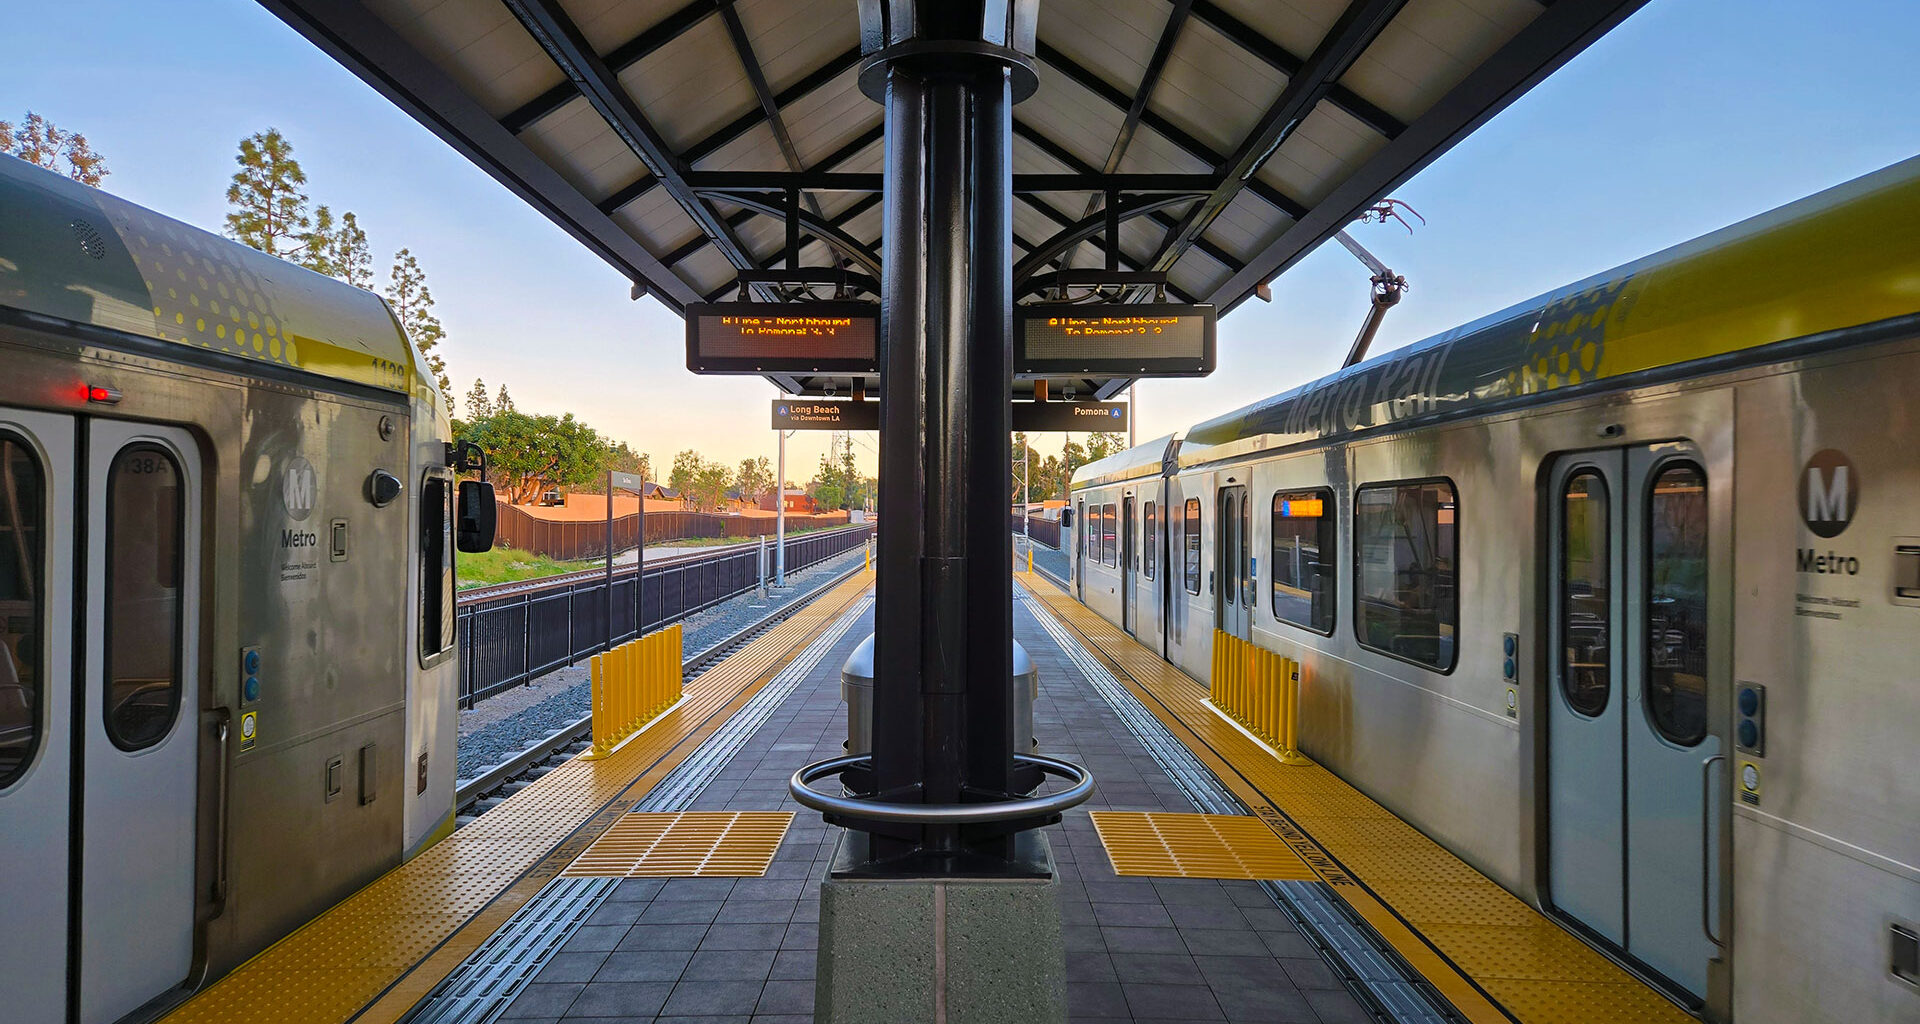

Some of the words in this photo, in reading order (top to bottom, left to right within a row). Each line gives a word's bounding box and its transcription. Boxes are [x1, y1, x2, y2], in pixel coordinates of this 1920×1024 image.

[1284, 368, 1368, 437] Metro
[1371, 328, 1462, 425] Rail
[790, 405, 811, 414] Long
[813, 405, 840, 414] Beach
[1074, 407, 1109, 416] Pomona
[281, 528, 317, 548] Metro
[1796, 548, 1860, 576] Metro
[1266, 819, 1304, 840] BEHIND
[1290, 841, 1335, 868] YELLOW
[1319, 868, 1355, 887] LINE
